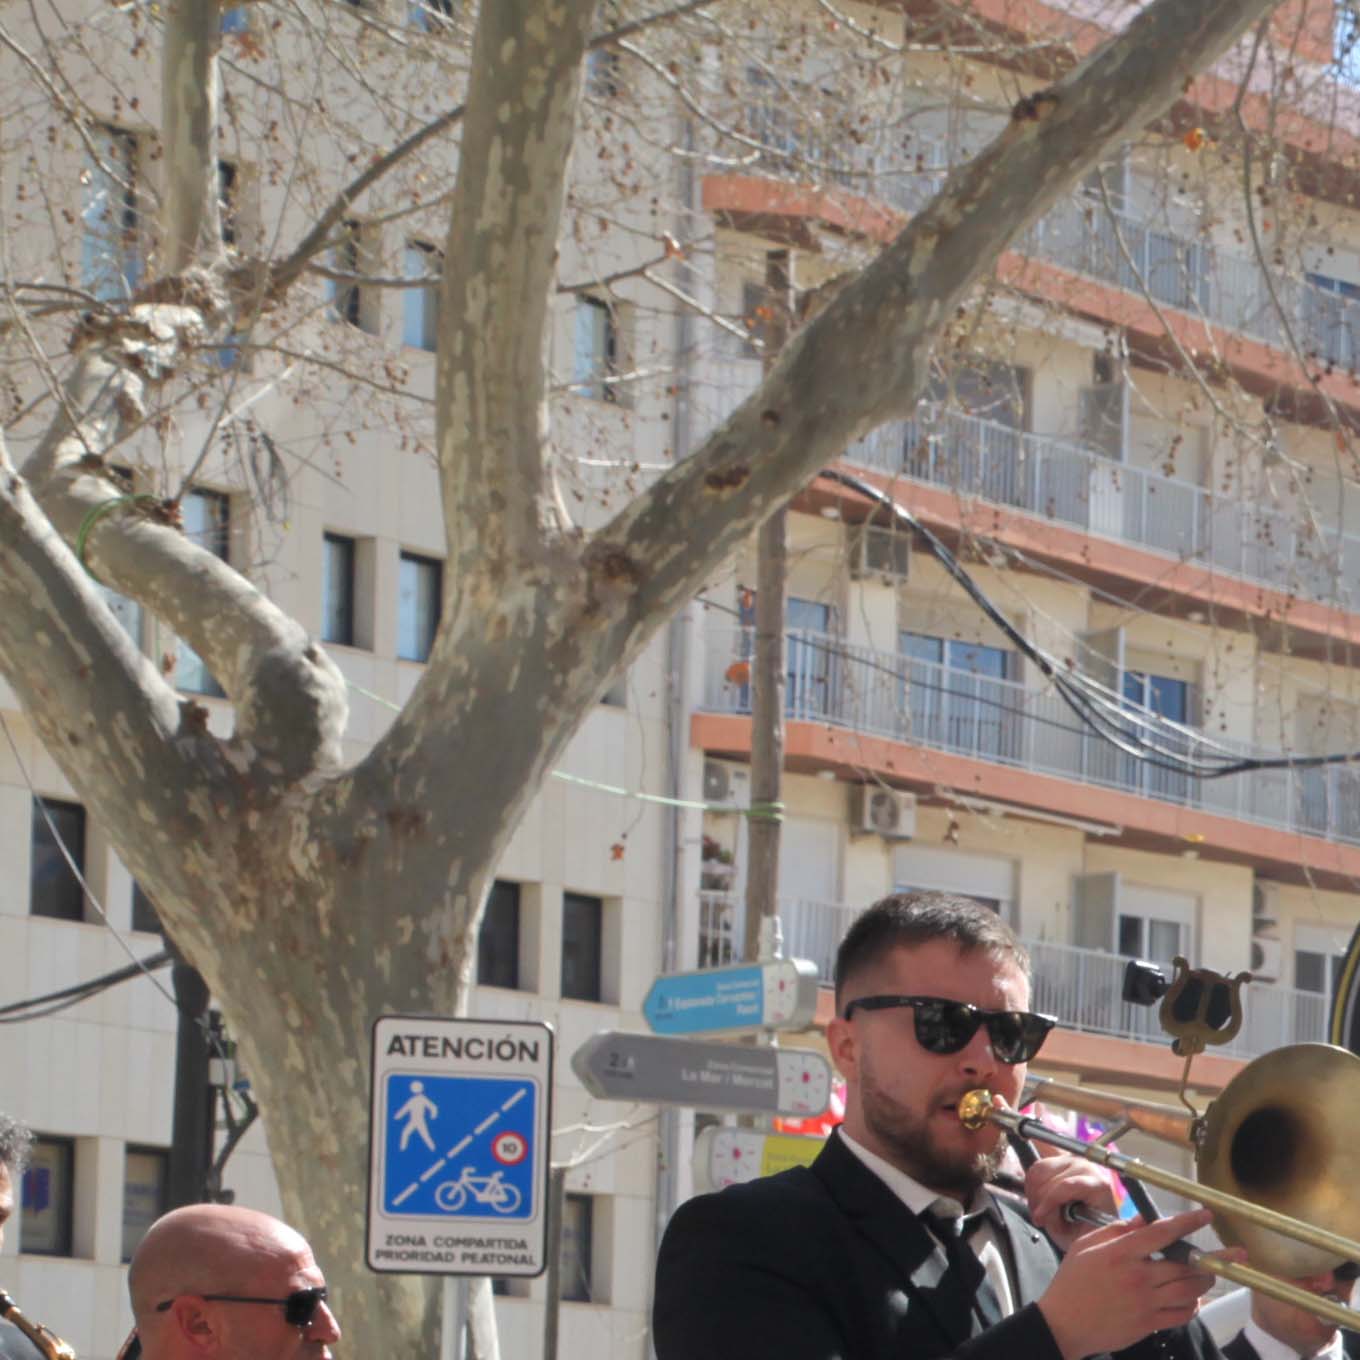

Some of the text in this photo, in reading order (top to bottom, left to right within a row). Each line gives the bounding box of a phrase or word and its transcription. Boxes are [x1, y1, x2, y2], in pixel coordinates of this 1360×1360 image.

[386, 1033, 540, 1063] ATENCIÓN
[502, 1142, 518, 1155] 10
[386, 1234, 528, 1250] ZONA COMPARTIDA
[375, 1250, 537, 1266] PRIORIDAD PEATONAL
